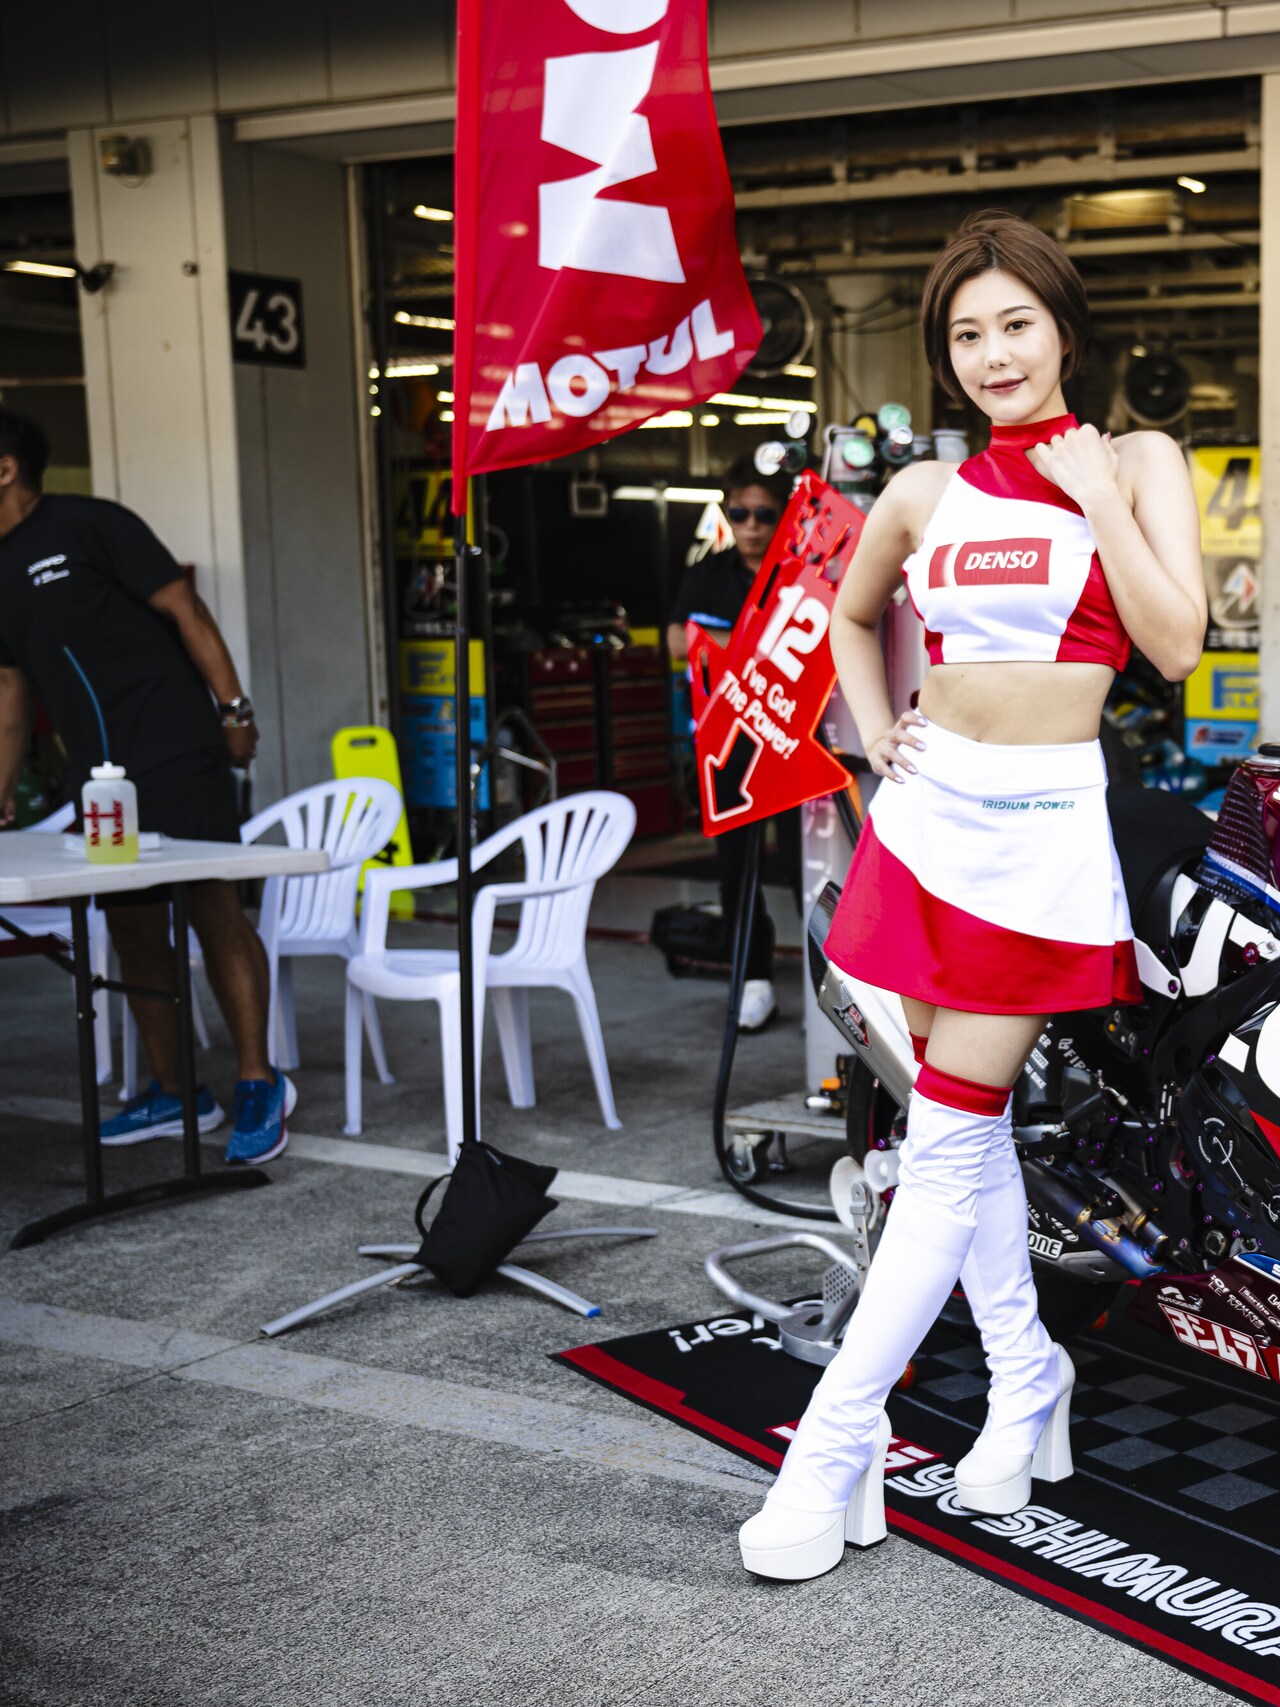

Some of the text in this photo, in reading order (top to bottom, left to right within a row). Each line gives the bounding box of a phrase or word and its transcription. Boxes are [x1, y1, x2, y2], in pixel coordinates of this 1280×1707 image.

[236, 289, 298, 352] 43
[485, 299, 735, 432] MOTUL
[965, 551, 1038, 570] DENSO
[757, 585, 830, 682] 12
[719, 669, 800, 760] The Power!
[741, 657, 797, 723] I've Got
[982, 801, 1075, 811] IRIDIUM POWER
